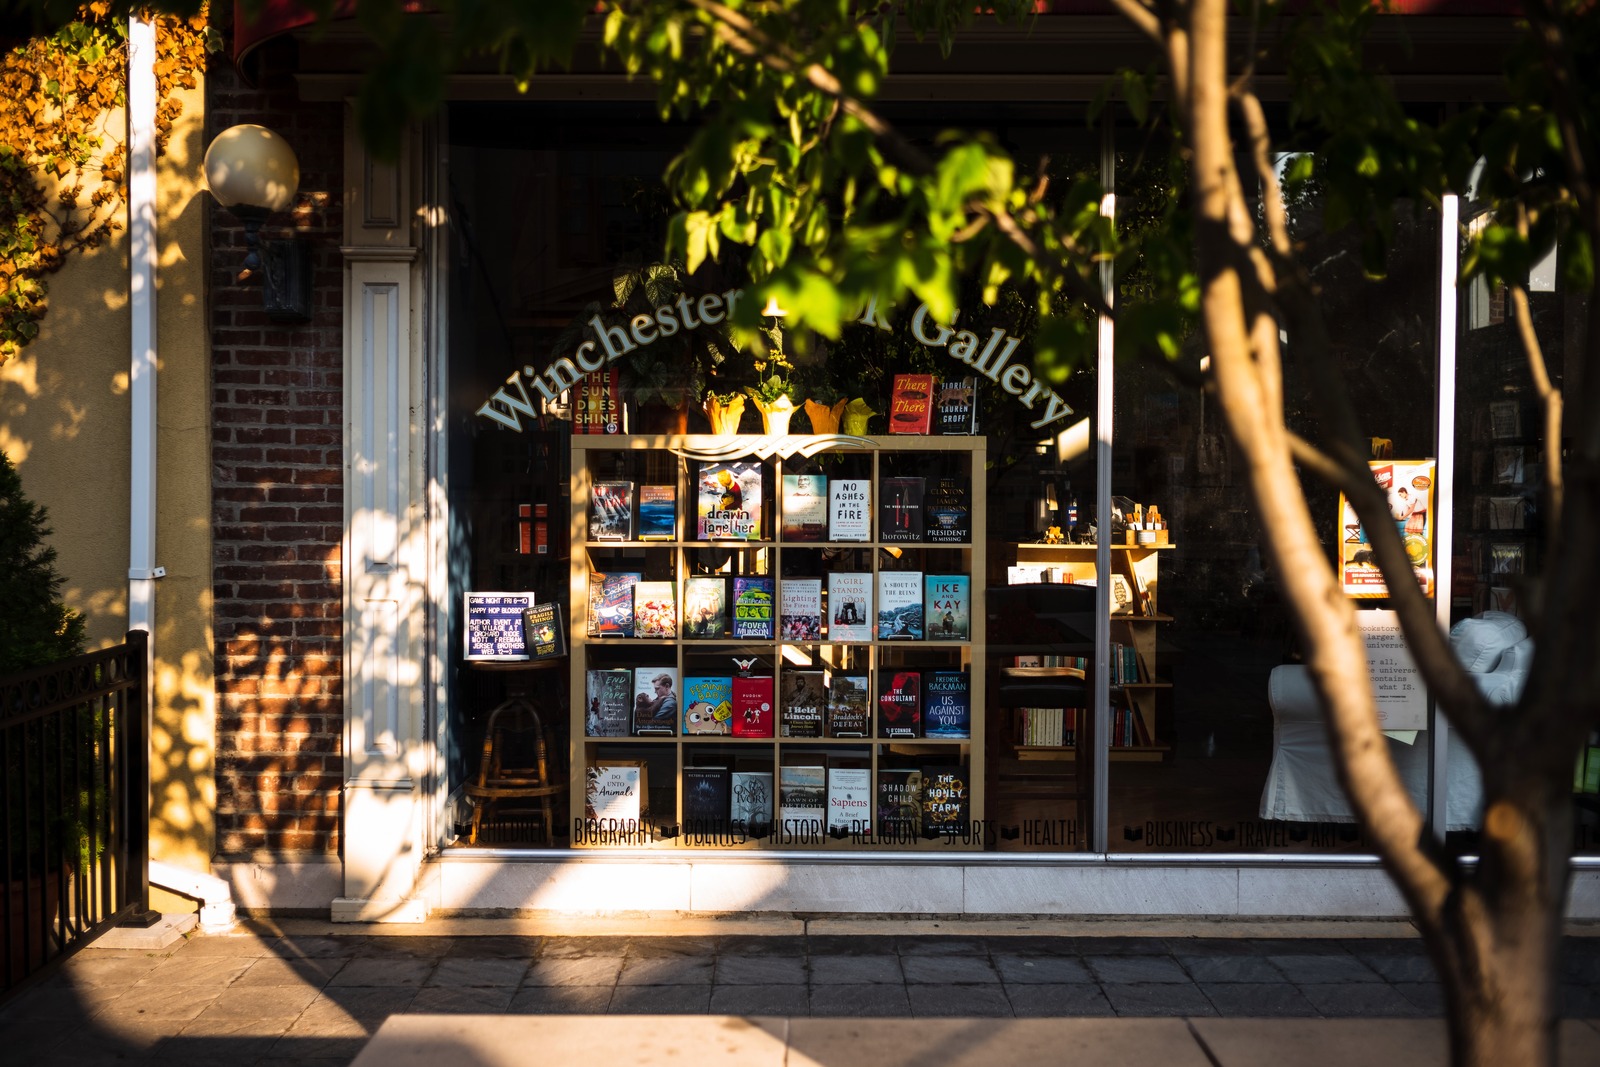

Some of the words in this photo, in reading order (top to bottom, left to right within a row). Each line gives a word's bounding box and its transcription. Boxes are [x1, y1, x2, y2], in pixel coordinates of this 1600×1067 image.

[475, 289, 745, 433] Winchester
[911, 301, 1074, 429] Gallery
[583, 372, 610, 383] THE
[896, 378, 928, 390] There
[582, 386, 610, 397] SUN
[577, 400, 616, 410] DOES
[894, 400, 926, 413] There
[941, 405, 968, 413] LAUREN
[575, 413, 618, 424] SHINE
[943, 414, 966, 423] GROFF
[842, 482, 857, 492] NO
[835, 492, 865, 501] ASHES
[707, 504, 750, 520] drawn
[703, 520, 755, 536] together
[882, 531, 920, 540] horowitz
[936, 584, 959, 593] IKE
[782, 594, 817, 603] Lighting
[933, 600, 961, 609] KAY
[529, 611, 554, 620] FRAGILE
[783, 608, 816, 616] Freedom
[531, 616, 554, 624] THINGS
[742, 621, 768, 629] FOVEA
[736, 628, 769, 636] MUNSON
[605, 676, 626, 684] END
[928, 682, 966, 691] BACKMAN
[602, 692, 626, 700] ROPE
[698, 691, 725, 701] BABY
[941, 696, 954, 705] US
[788, 706, 793, 714] I
[794, 706, 817, 714] Held
[929, 705, 966, 716] AGAINST
[784, 712, 821, 720] Lincoln
[833, 712, 863, 720] Braddock's
[938, 715, 957, 725] YOU
[937, 774, 954, 783] THE
[598, 786, 634, 797] Animals
[882, 783, 917, 792] SHADOW
[737, 791, 768, 804] IVORY
[929, 788, 962, 798] HONEY
[831, 797, 868, 809] Sapiens
[888, 794, 913, 803] CHILD
[932, 803, 960, 812] FARM
[574, 817, 656, 844] BIOGRAPHY
[685, 819, 746, 844] POLITICS
[770, 819, 827, 845] HISTORY
[852, 819, 917, 845] RELIGION
[943, 819, 996, 845] SPORTS
[1023, 819, 1078, 846] HEALTH
[1145, 821, 1213, 847] BUSINESS
[1237, 821, 1289, 847] TRAVEL
[1311, 822, 1336, 847] ART
